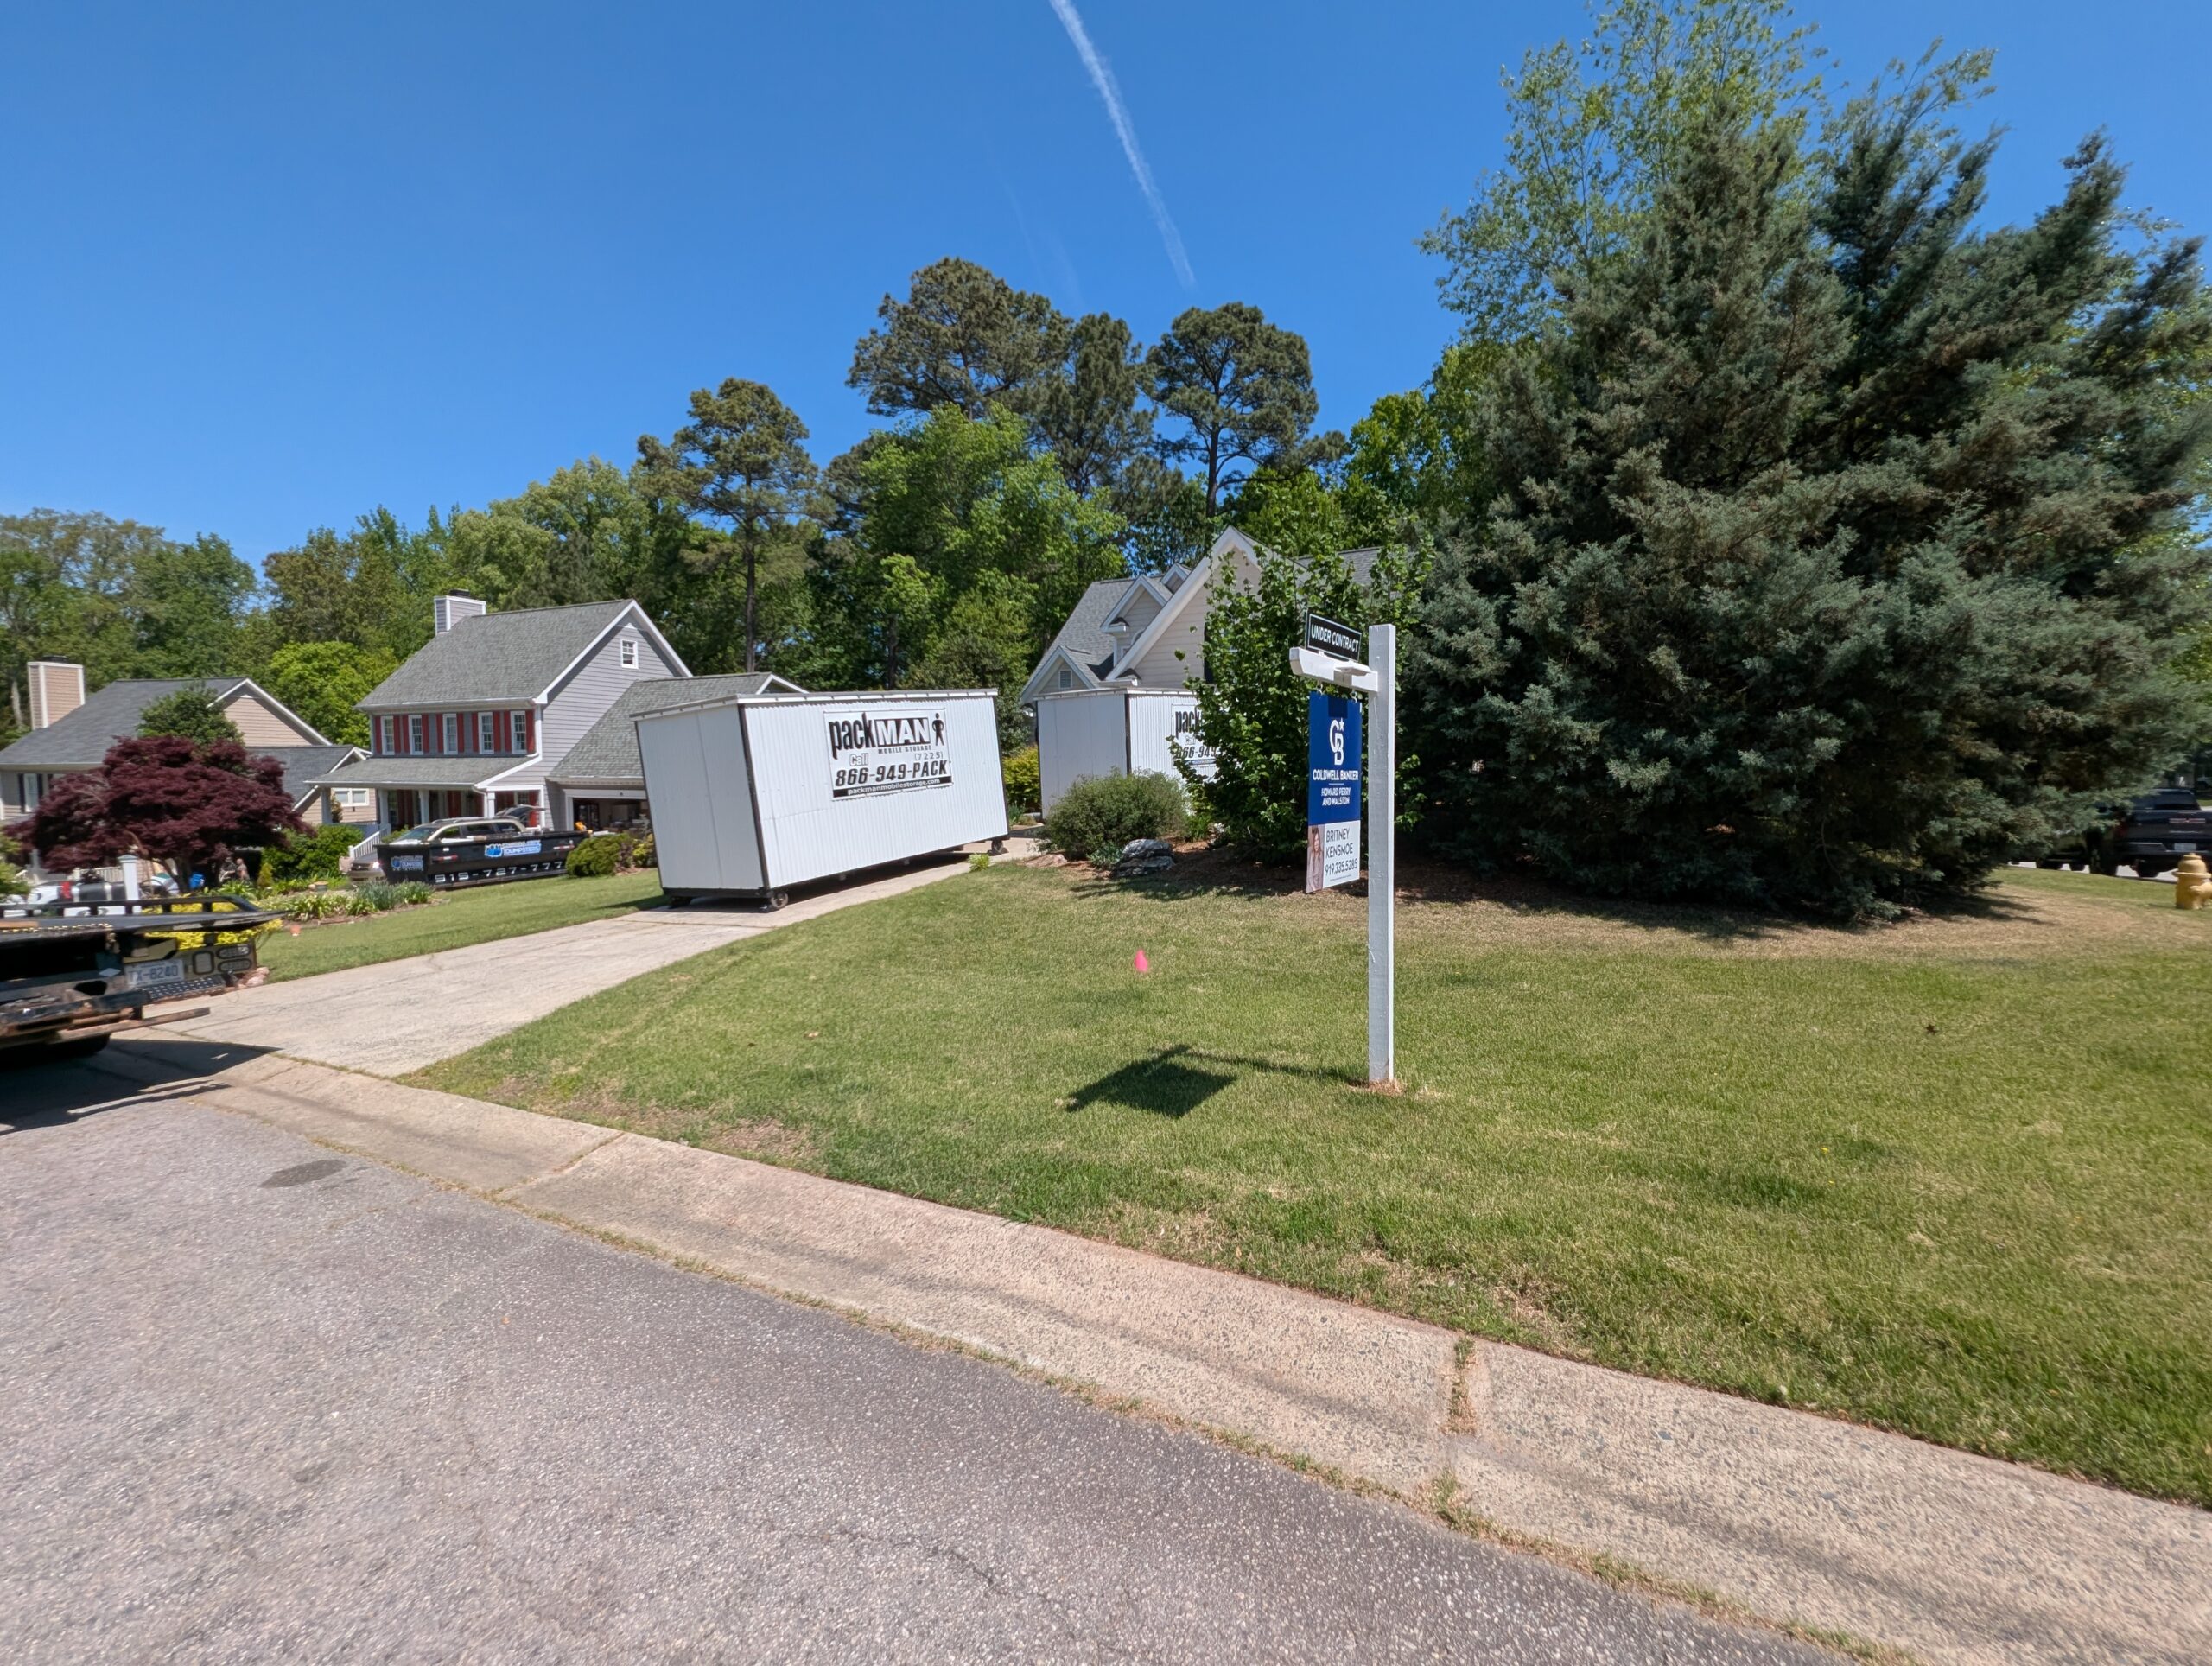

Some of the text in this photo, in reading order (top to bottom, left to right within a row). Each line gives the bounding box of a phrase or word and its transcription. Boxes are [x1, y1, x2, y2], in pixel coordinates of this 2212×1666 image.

[1311, 624, 1359, 652] UNDER CONTRACT
[849, 753, 869, 766] Call
[914, 751, 944, 760] (7225)
[836, 760, 948, 786] 866-949-PACK
[1313, 769, 1359, 781] COLDWELL BANKER
[847, 778, 941, 796] packmanmobilestorage.com
[1322, 798, 1331, 806] AND
[1326, 828, 1351, 843] BRITNEY
[435, 861, 563, 883] 919-727-777
